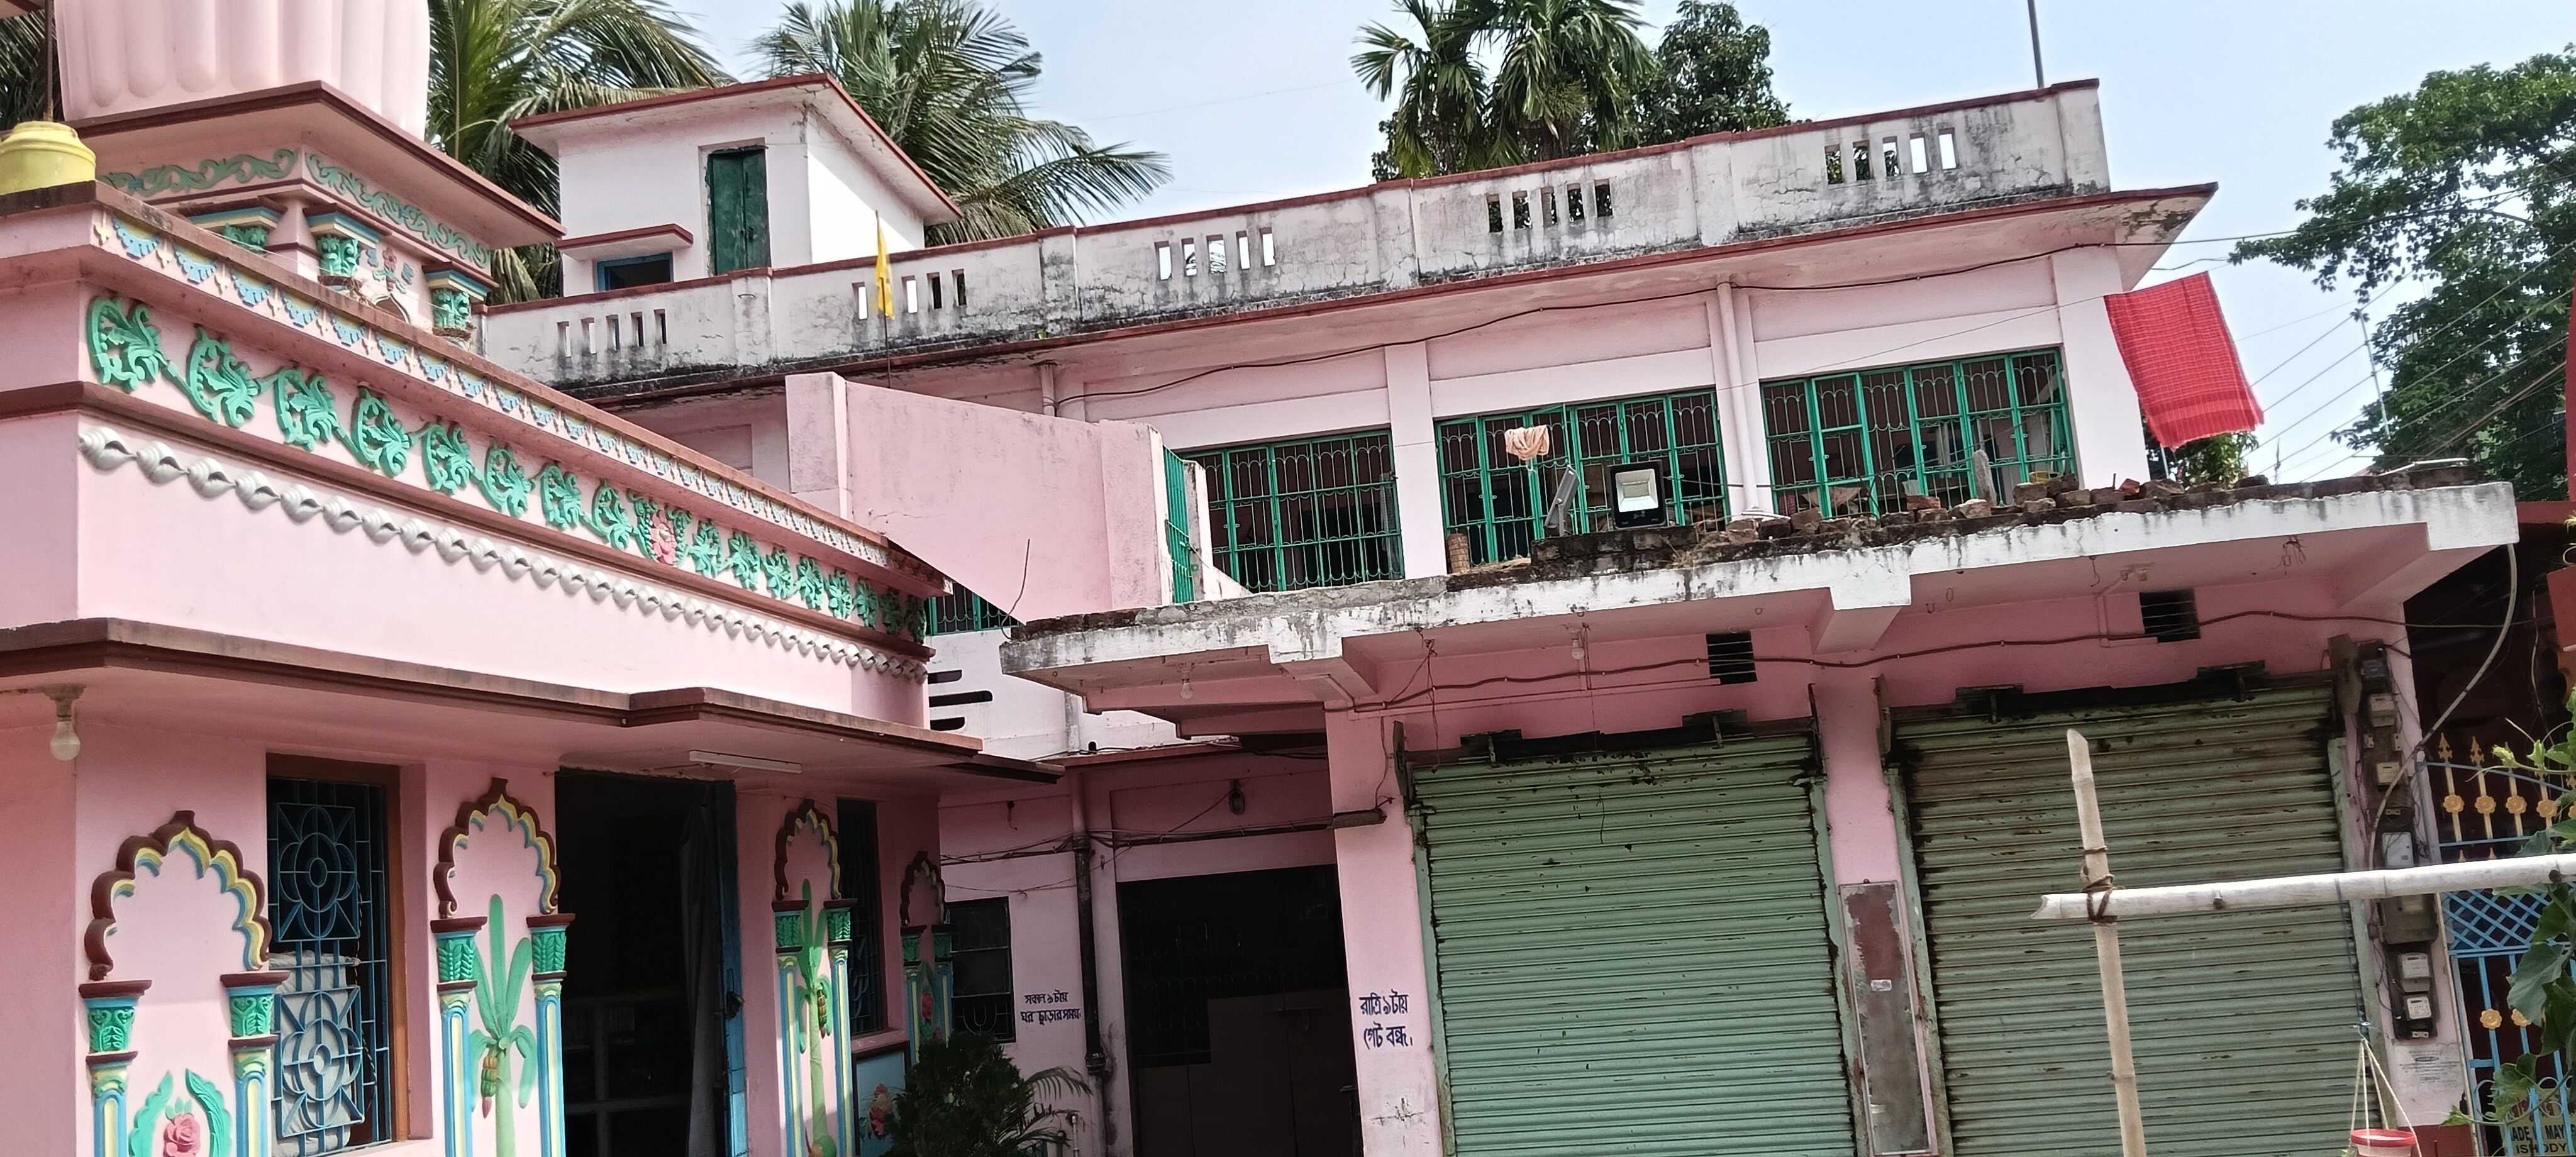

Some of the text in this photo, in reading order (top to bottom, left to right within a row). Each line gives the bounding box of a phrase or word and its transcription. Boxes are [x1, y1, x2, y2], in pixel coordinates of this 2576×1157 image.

[1024, 994, 1046, 1004] সকাল
[1358, 992, 1382, 1016] রাত্রি
[1021, 1011, 1035, 1022] ঘর
[1363, 1021, 1383, 1050] গেট
[2511, 1126, 2529, 1141] ADE
